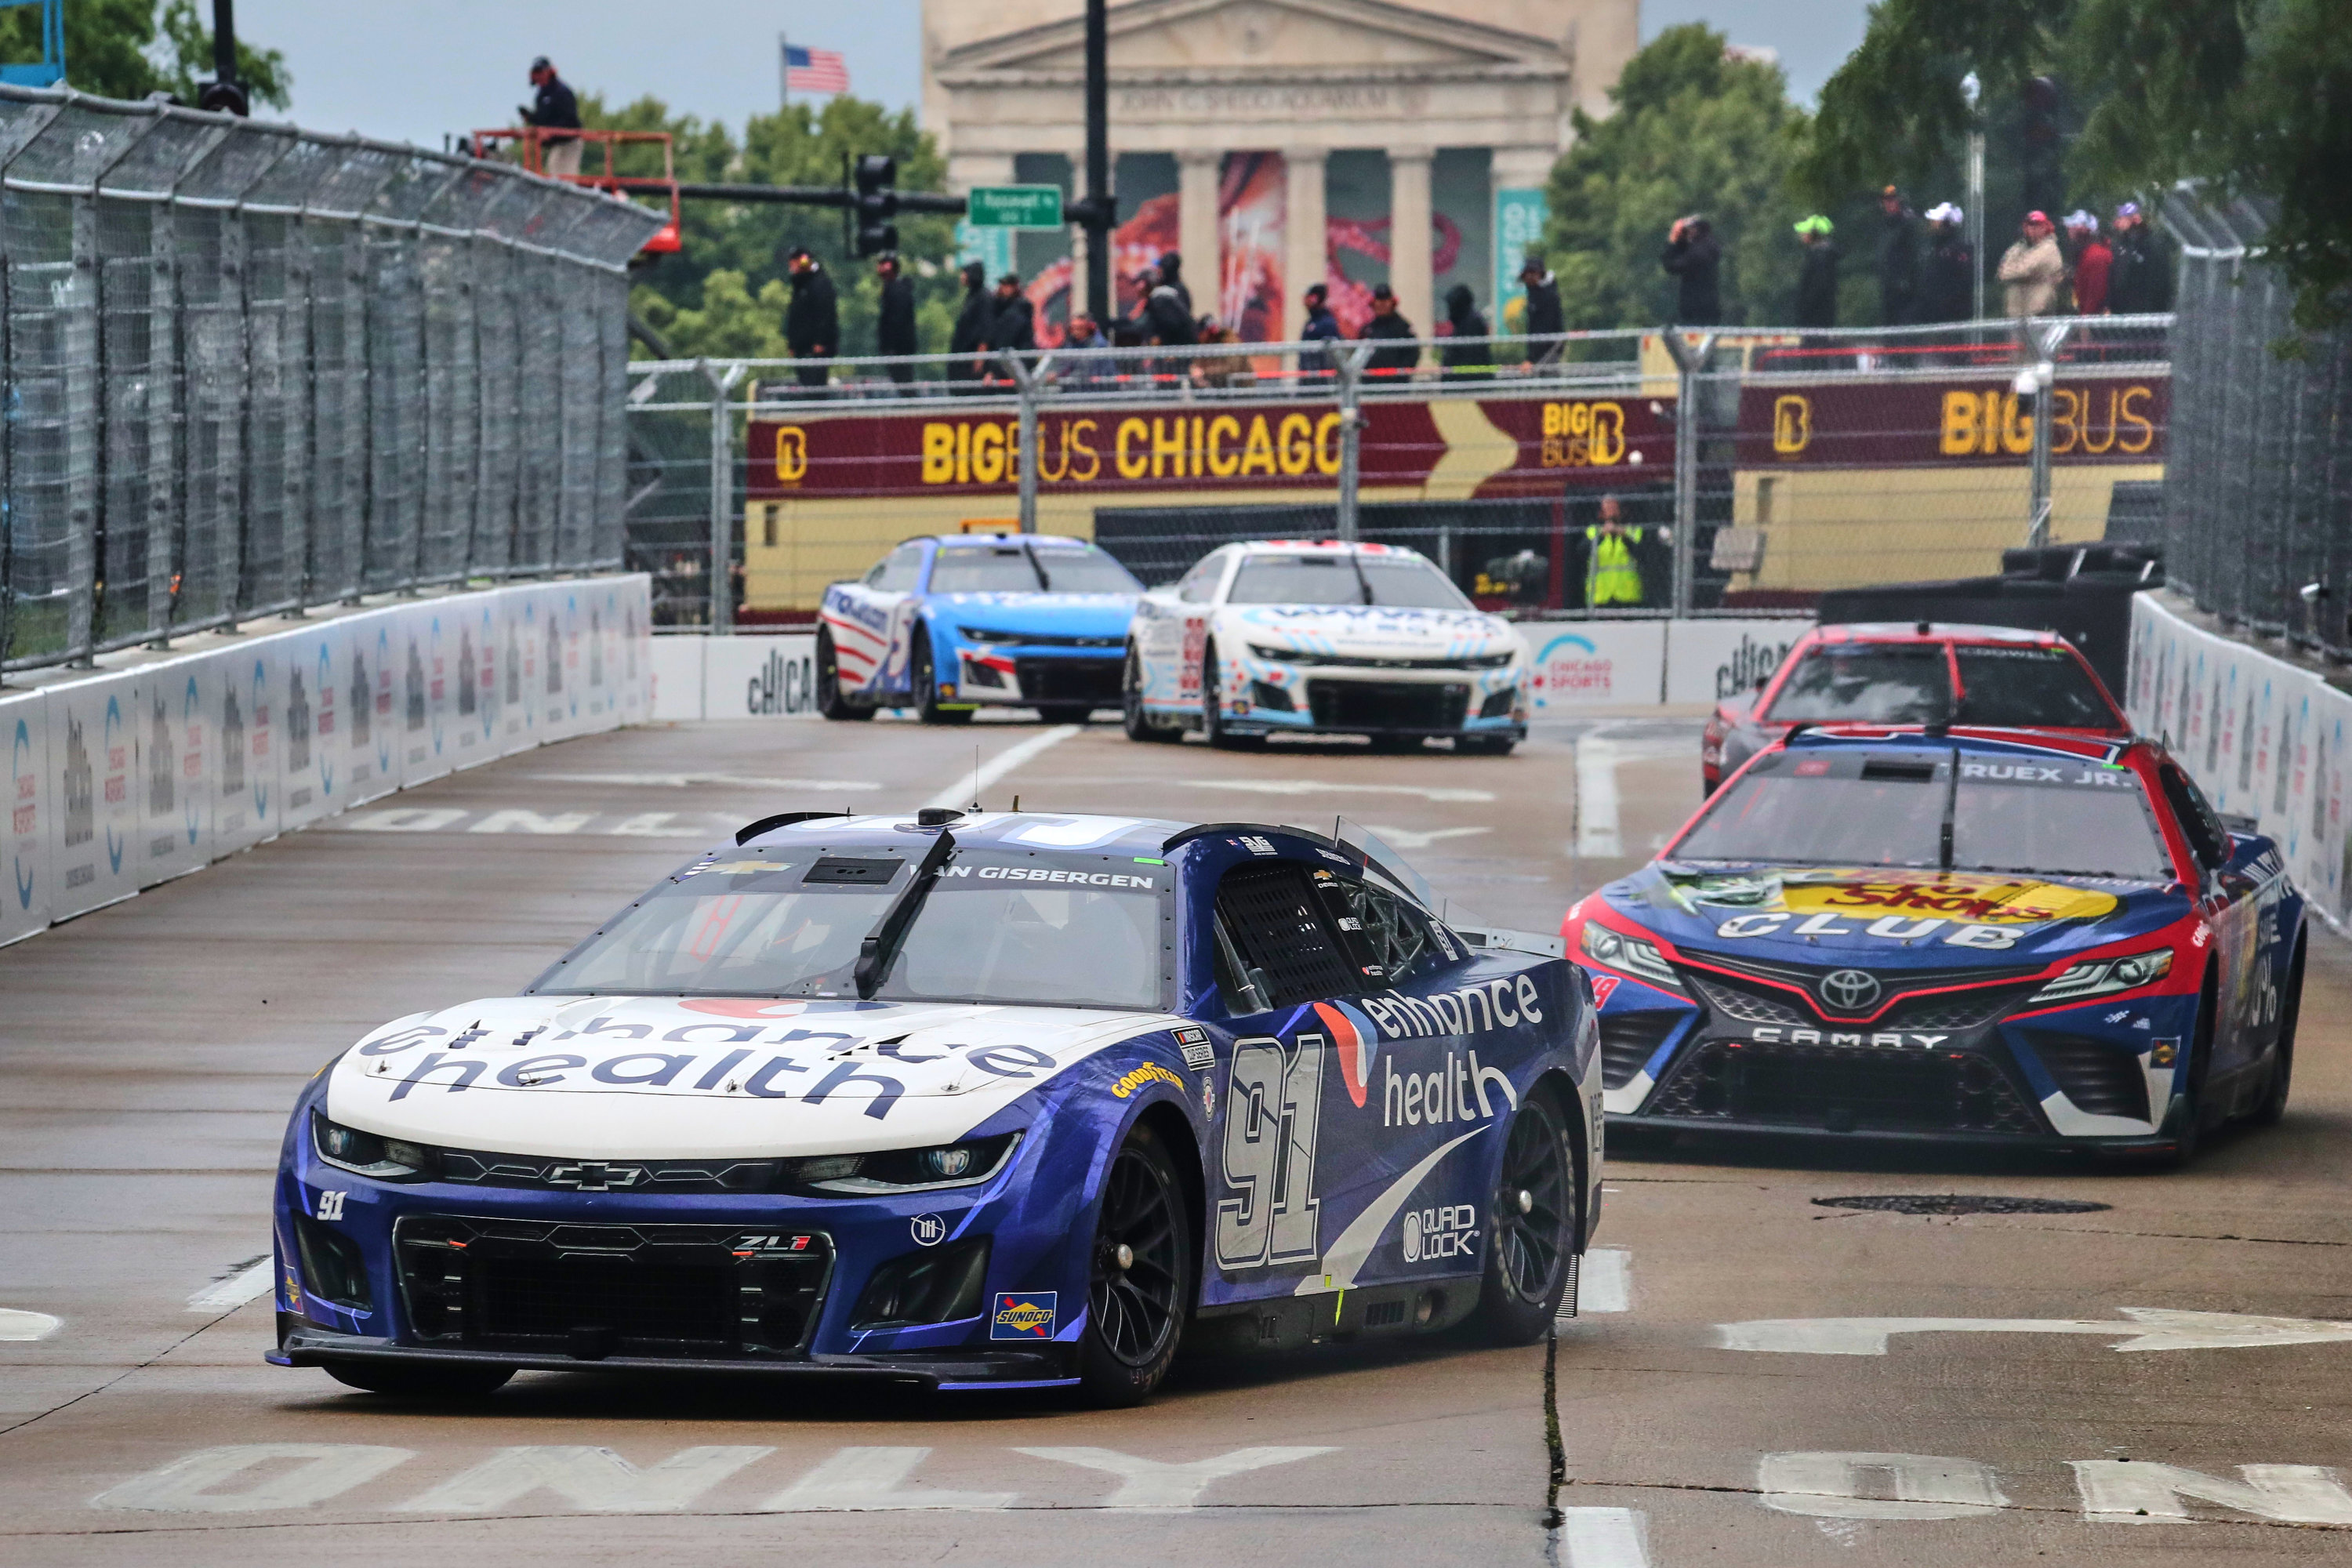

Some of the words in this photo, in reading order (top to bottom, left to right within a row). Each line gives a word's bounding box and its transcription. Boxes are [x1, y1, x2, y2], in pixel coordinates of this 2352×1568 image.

[1542, 402, 1588, 436] BIG
[1541, 437, 1588, 467] BUS
[1551, 659, 1613, 673] CHICAGO
[1551, 675, 1612, 691] SPORTS
[1939, 762, 2062, 782] TRUEX
[2074, 770, 2132, 787] JR.
[978, 866, 1154, 890] GISBERGEN
[1716, 912, 2026, 950] CLUB
[1360, 974, 1544, 1040] enhance
[358, 1015, 1058, 1079] enhance
[1751, 1026, 1948, 1049] CAMRY
[387, 1047, 907, 1121] health
[1384, 1049, 1518, 1127] health
[1214, 1033, 1326, 1272] 91
[317, 1190, 348, 1221] 91
[1421, 1204, 1475, 1231] QUAD
[734, 1235, 811, 1251] ZL1
[1421, 1229, 1475, 1258] LOCK
[997, 1308, 1053, 1324] SUNOCO
[85, 1443, 1345, 1517] ONLY
